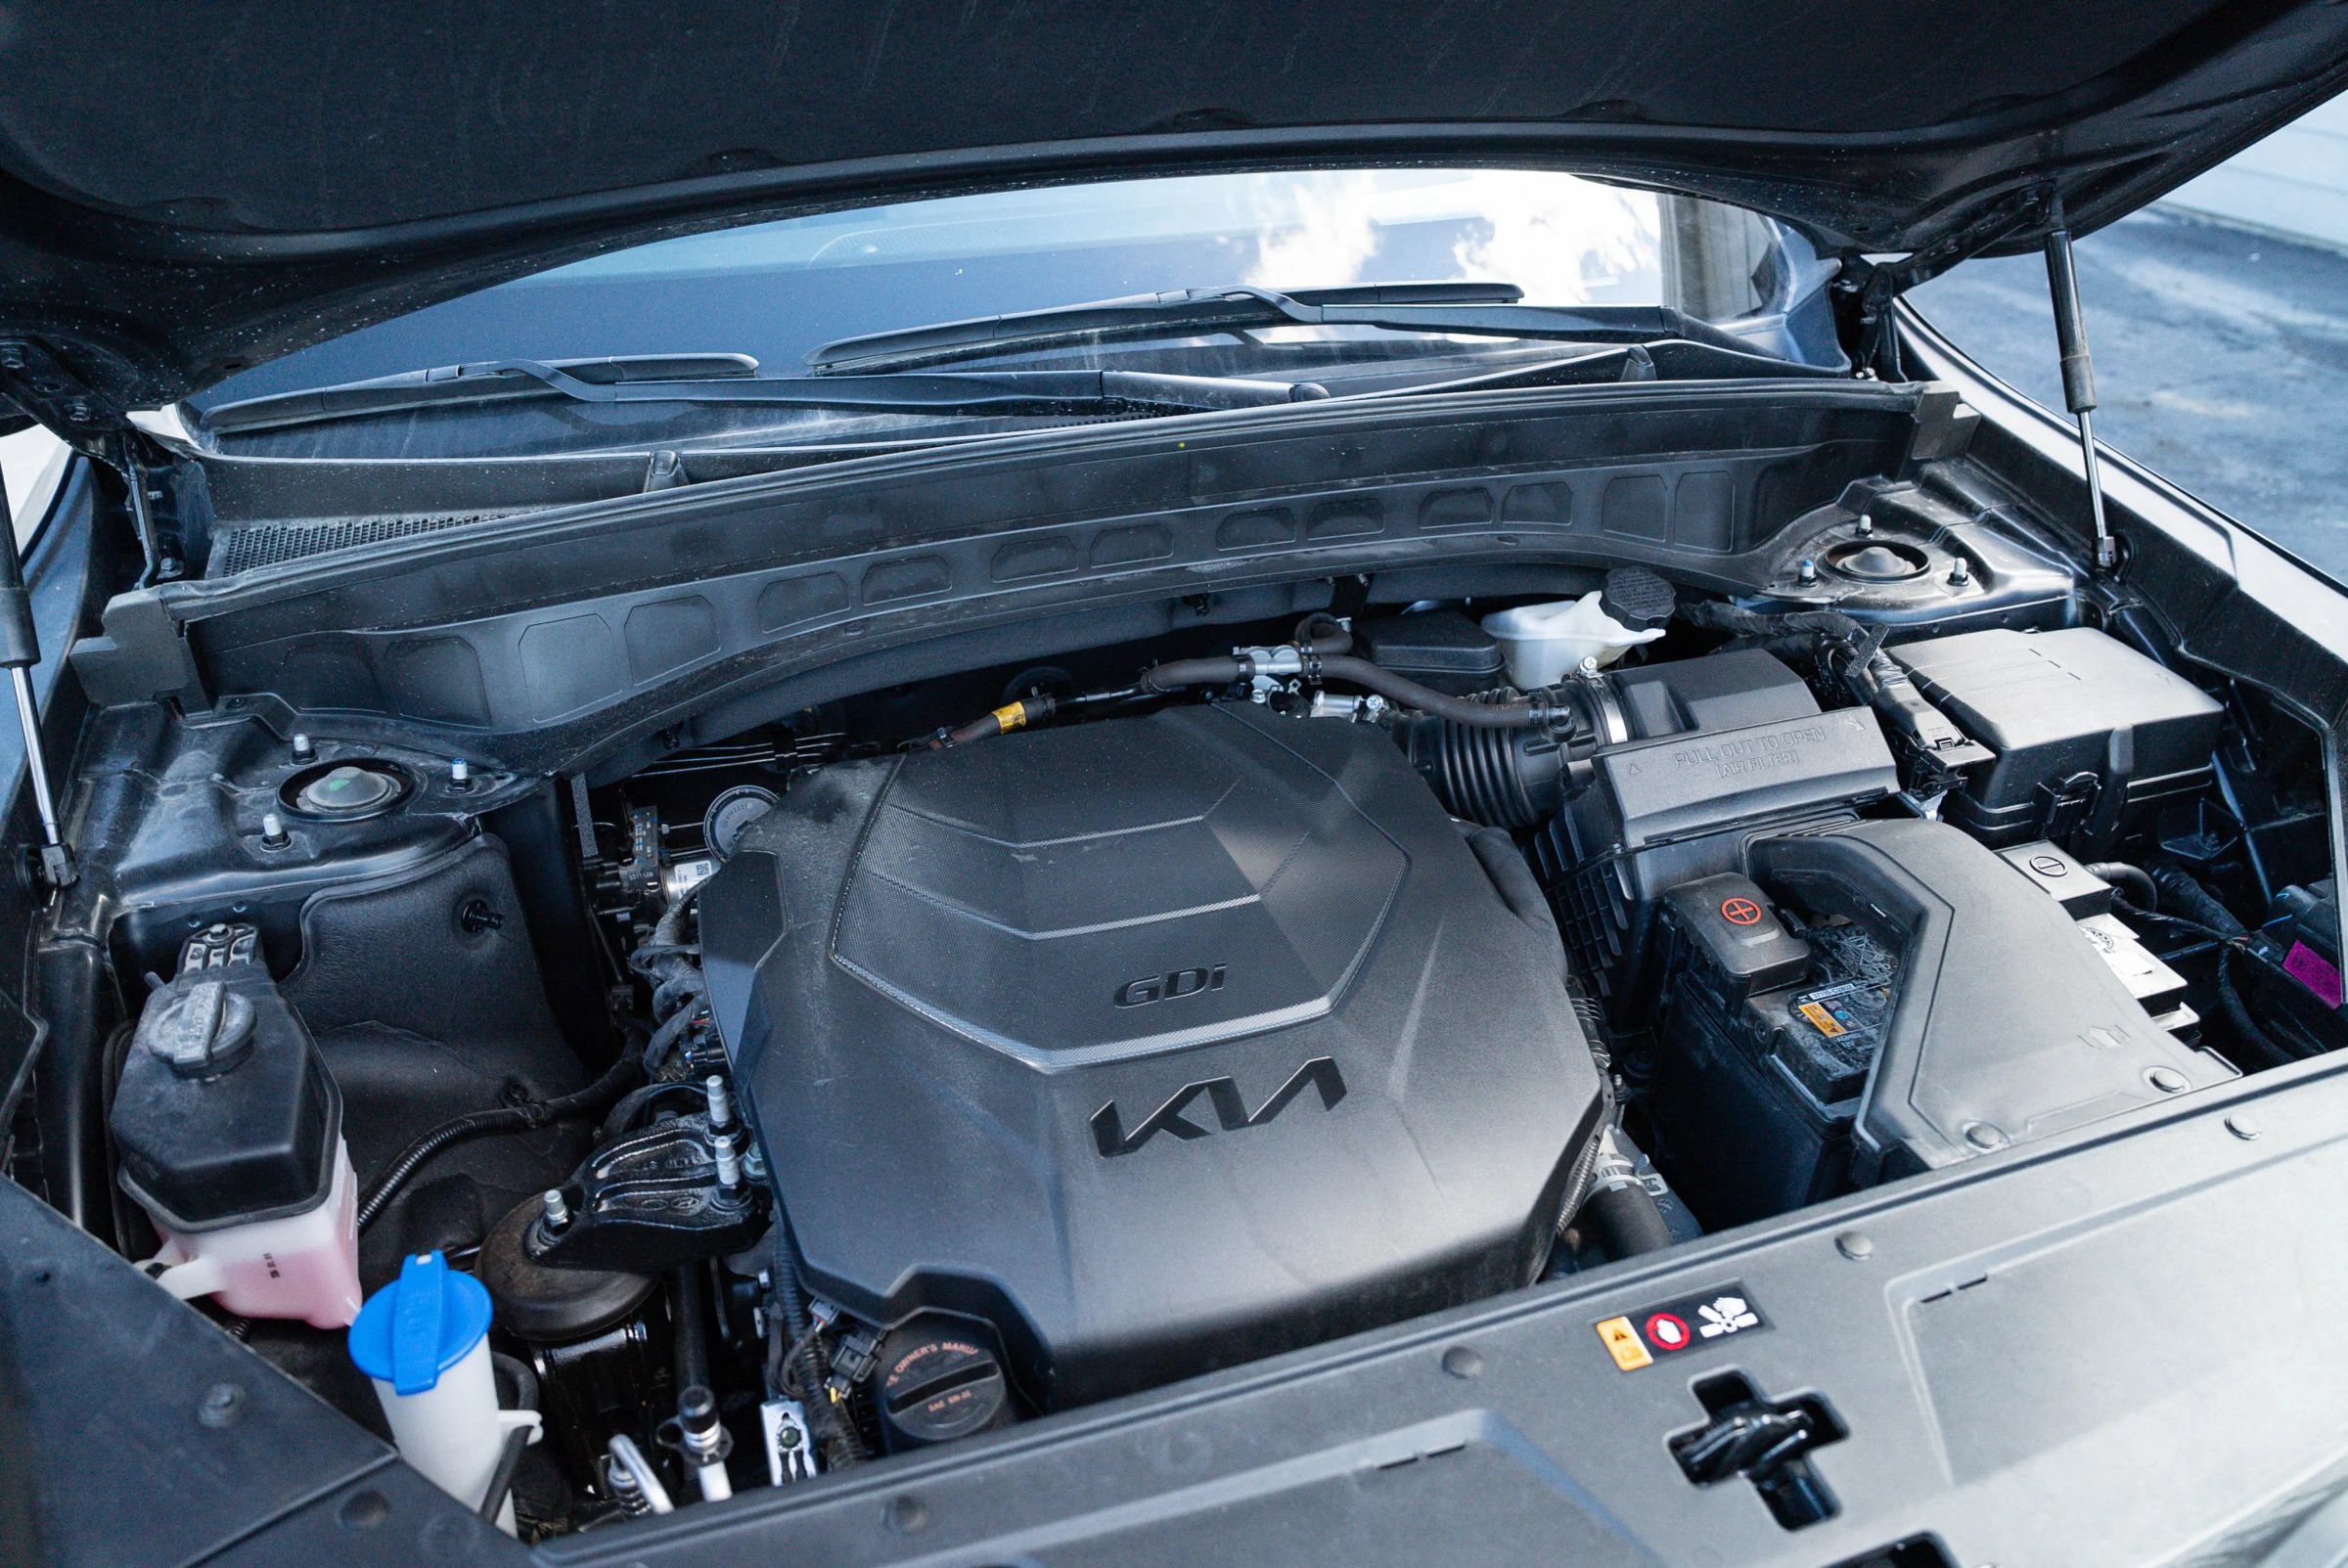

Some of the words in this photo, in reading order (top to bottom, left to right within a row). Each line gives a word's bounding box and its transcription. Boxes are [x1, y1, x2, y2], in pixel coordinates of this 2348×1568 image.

[1674, 749, 1718, 768] PULL
[1721, 740, 1753, 759] OUT
[1758, 736, 1779, 750] TO
[1784, 726, 1826, 746] OPEN
[1090, 1056, 1347, 1158] KIA
